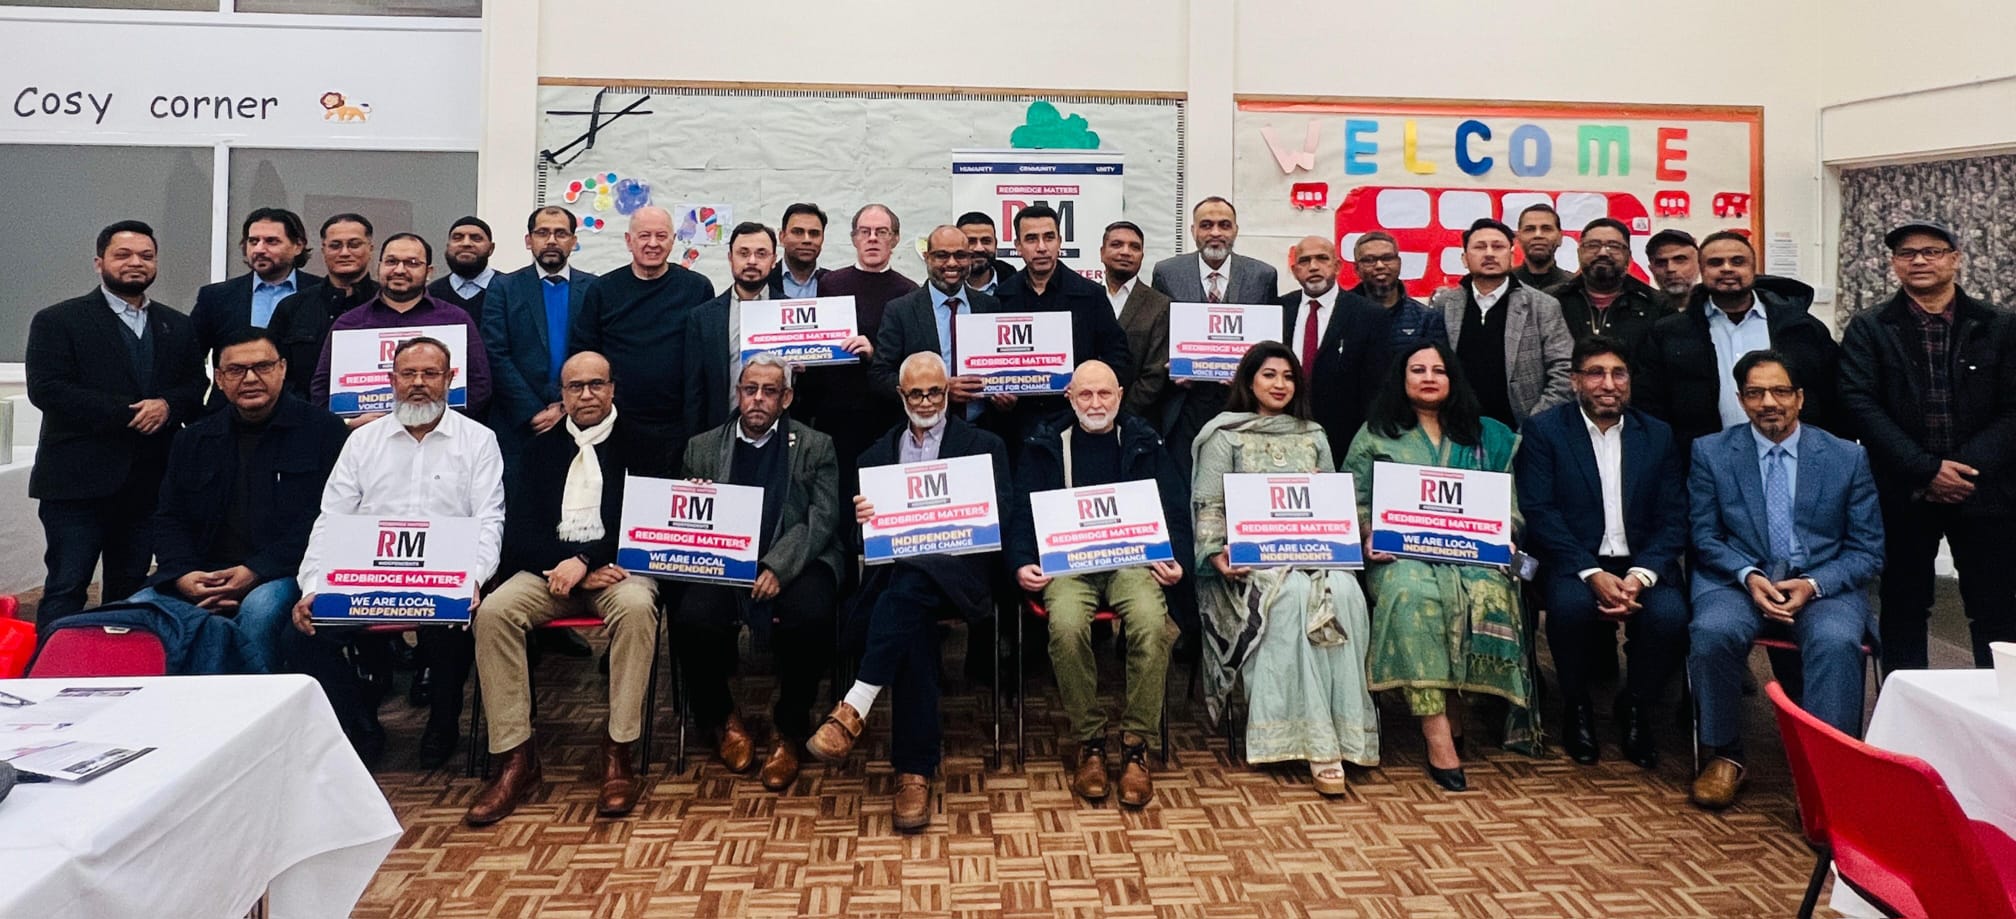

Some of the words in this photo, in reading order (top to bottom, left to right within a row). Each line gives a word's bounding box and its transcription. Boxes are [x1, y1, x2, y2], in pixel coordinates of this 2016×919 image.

[14, 87, 112, 124] Cosy
[151, 95, 278, 119] corner
[1260, 119, 1688, 182] WELCOME
[781, 307, 816, 325] RM
[1209, 315, 1243, 334] RM
[754, 333, 805, 343] REDBRIDGE
[806, 331, 847, 340] MATTERS
[998, 324, 1032, 345] RM
[970, 357, 1021, 366] REDBRIDGE
[1022, 355, 1063, 365] MATTERS
[359, 402, 384, 410] VOICE
[906, 472, 948, 500] RM
[1421, 479, 1462, 505] RM
[1269, 486, 1311, 509] RM
[671, 494, 714, 521] RM
[877, 512, 936, 526] REDBRIDGE
[937, 505, 984, 519] MATTERS
[1077, 496, 1118, 520] RM
[1242, 524, 1298, 532] REDBRIDGE
[1300, 523, 1346, 532] MATTERS
[1387, 513, 1446, 527] REDBRIDGE
[1448, 518, 1497, 532] MATTERS
[635, 530, 695, 544] REDBRIDGE
[696, 535, 746, 548] MATTERS
[891, 528, 973, 546] INDEPENDENT
[1052, 530, 1108, 544] REDBRIDGE
[1110, 525, 1155, 538] MATTERS
[1403, 535, 1420, 544] WE
[1422, 536, 1443, 546] ARE
[1445, 538, 1478, 550] LOCAL
[376, 530, 426, 558] RM
[893, 543, 918, 554] VOICE
[920, 543, 937, 552] FOR
[938, 537, 973, 549] CHANGE
[1259, 544, 1275, 552] WE
[1278, 544, 1297, 552] ARE
[1299, 543, 1332, 552] LOCAL
[1403, 544, 1479, 559] INDEPENDENTS
[649, 552, 667, 562] WE
[669, 554, 690, 564] ARE
[692, 555, 725, 567] LOCAL
[1067, 545, 1145, 561] INDEPENDENT
[1069, 558, 1094, 569] VOICE
[1095, 557, 1112, 566] FOR
[1113, 554, 1148, 564] CHANGE
[1261, 552, 1333, 561] INDEPENDENTS
[648, 562, 725, 576] INDEPENDENTS
[335, 573, 403, 584] REDBRIDGE
[405, 574, 460, 585] MATTERS
[350, 597, 371, 606] WE
[373, 597, 396, 607] ARE
[398, 597, 436, 607] LOCAL
[349, 607, 435, 617] INDEPENDENTS
